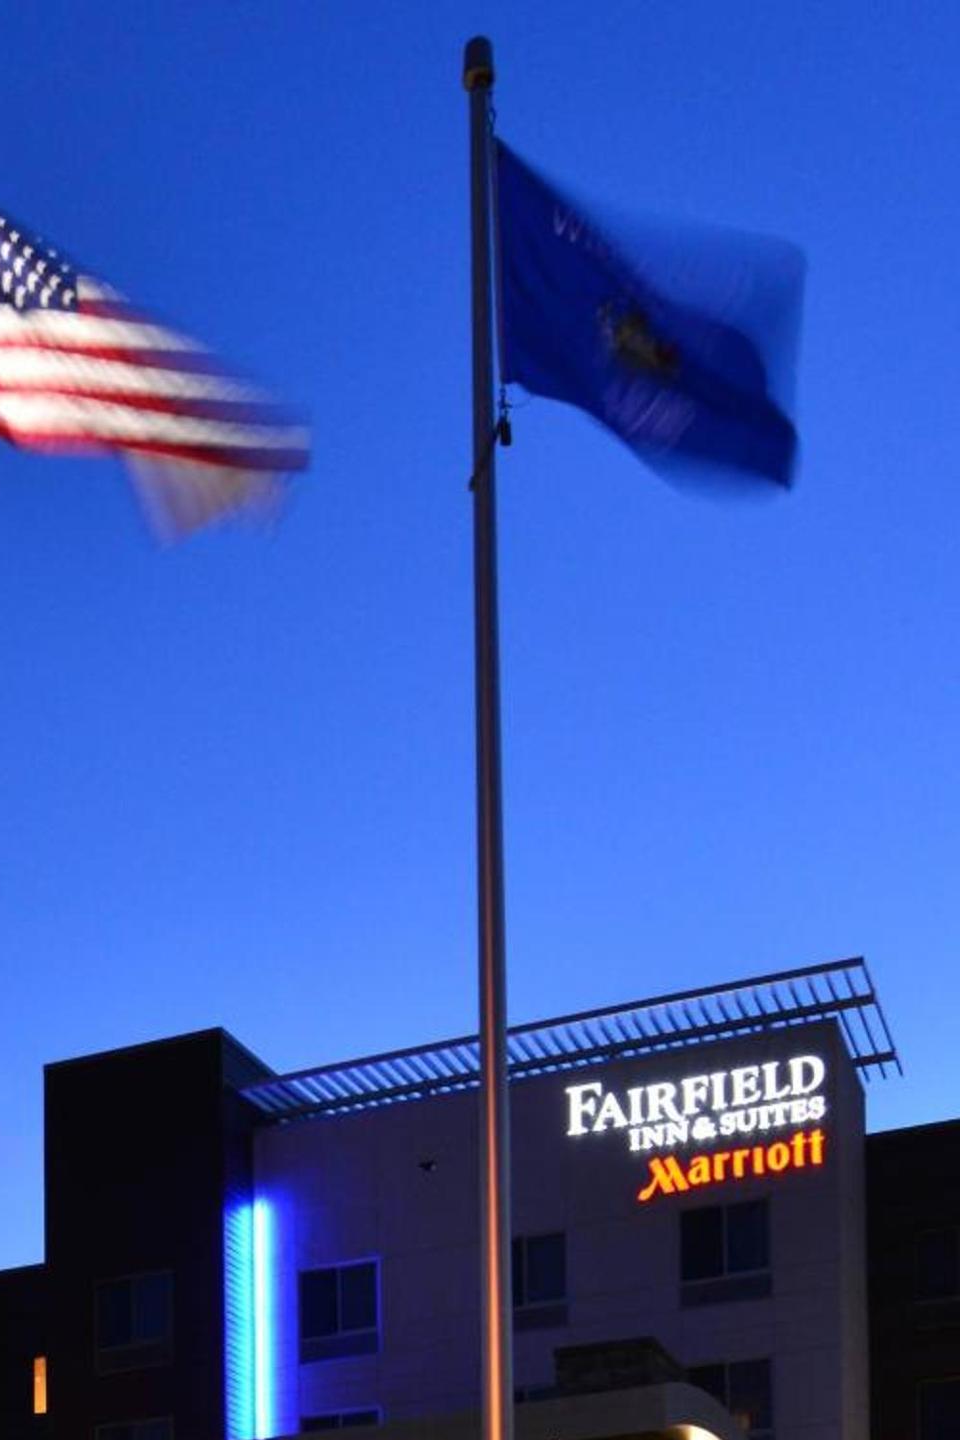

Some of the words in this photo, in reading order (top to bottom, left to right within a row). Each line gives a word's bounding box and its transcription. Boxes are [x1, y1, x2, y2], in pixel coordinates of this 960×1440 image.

[565, 1054, 826, 1136] FAIRFIELD
[628, 1119, 689, 1152] INN
[719, 1096, 826, 1136] SUITES
[637, 1128, 827, 1202] Marriott
